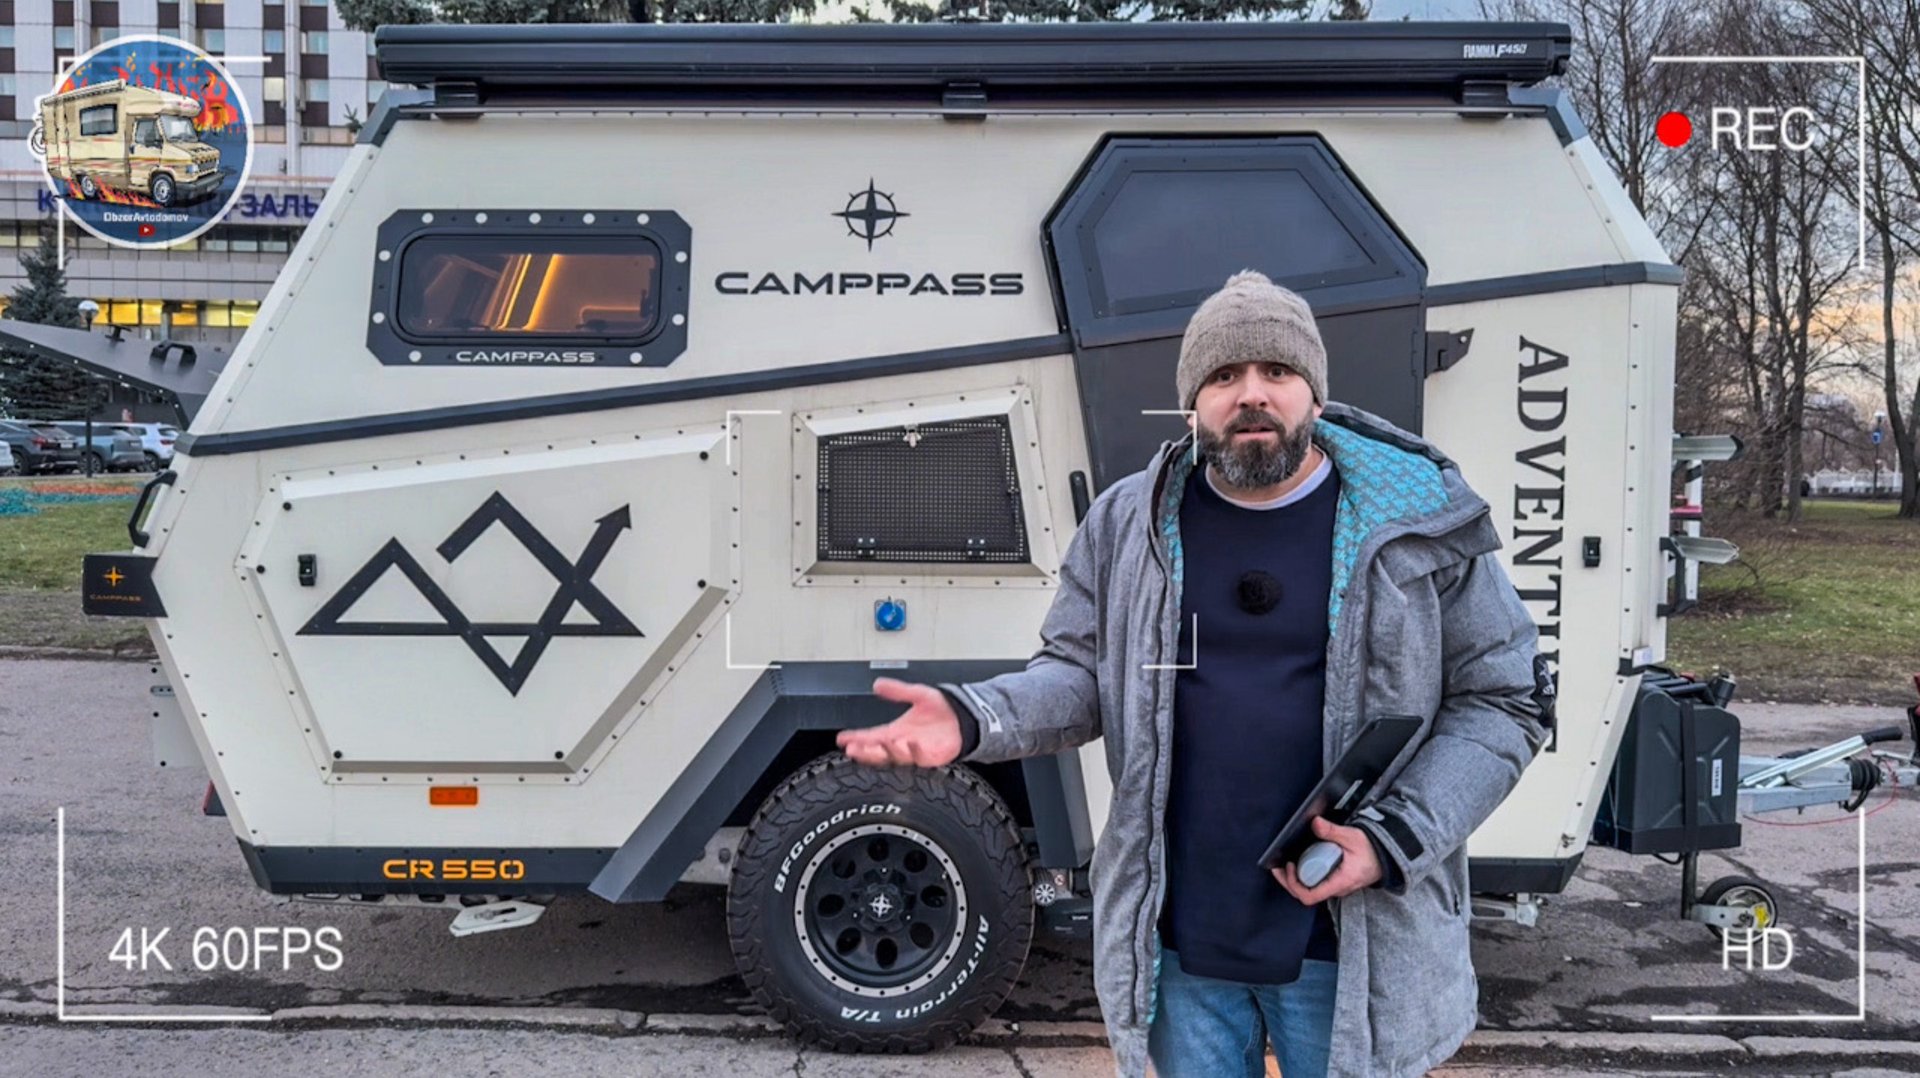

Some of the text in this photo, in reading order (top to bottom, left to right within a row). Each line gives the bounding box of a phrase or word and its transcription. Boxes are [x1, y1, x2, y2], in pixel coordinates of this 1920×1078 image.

[714, 272, 1024, 296] CAMPPASS
[455, 351, 596, 363] CAMPPASS
[1512, 335, 1569, 752] ADVENT
[383, 859, 525, 880] CR 550
[774, 803, 902, 893] BFGoodrich
[841, 914, 989, 1022] All-Terrain T/A
